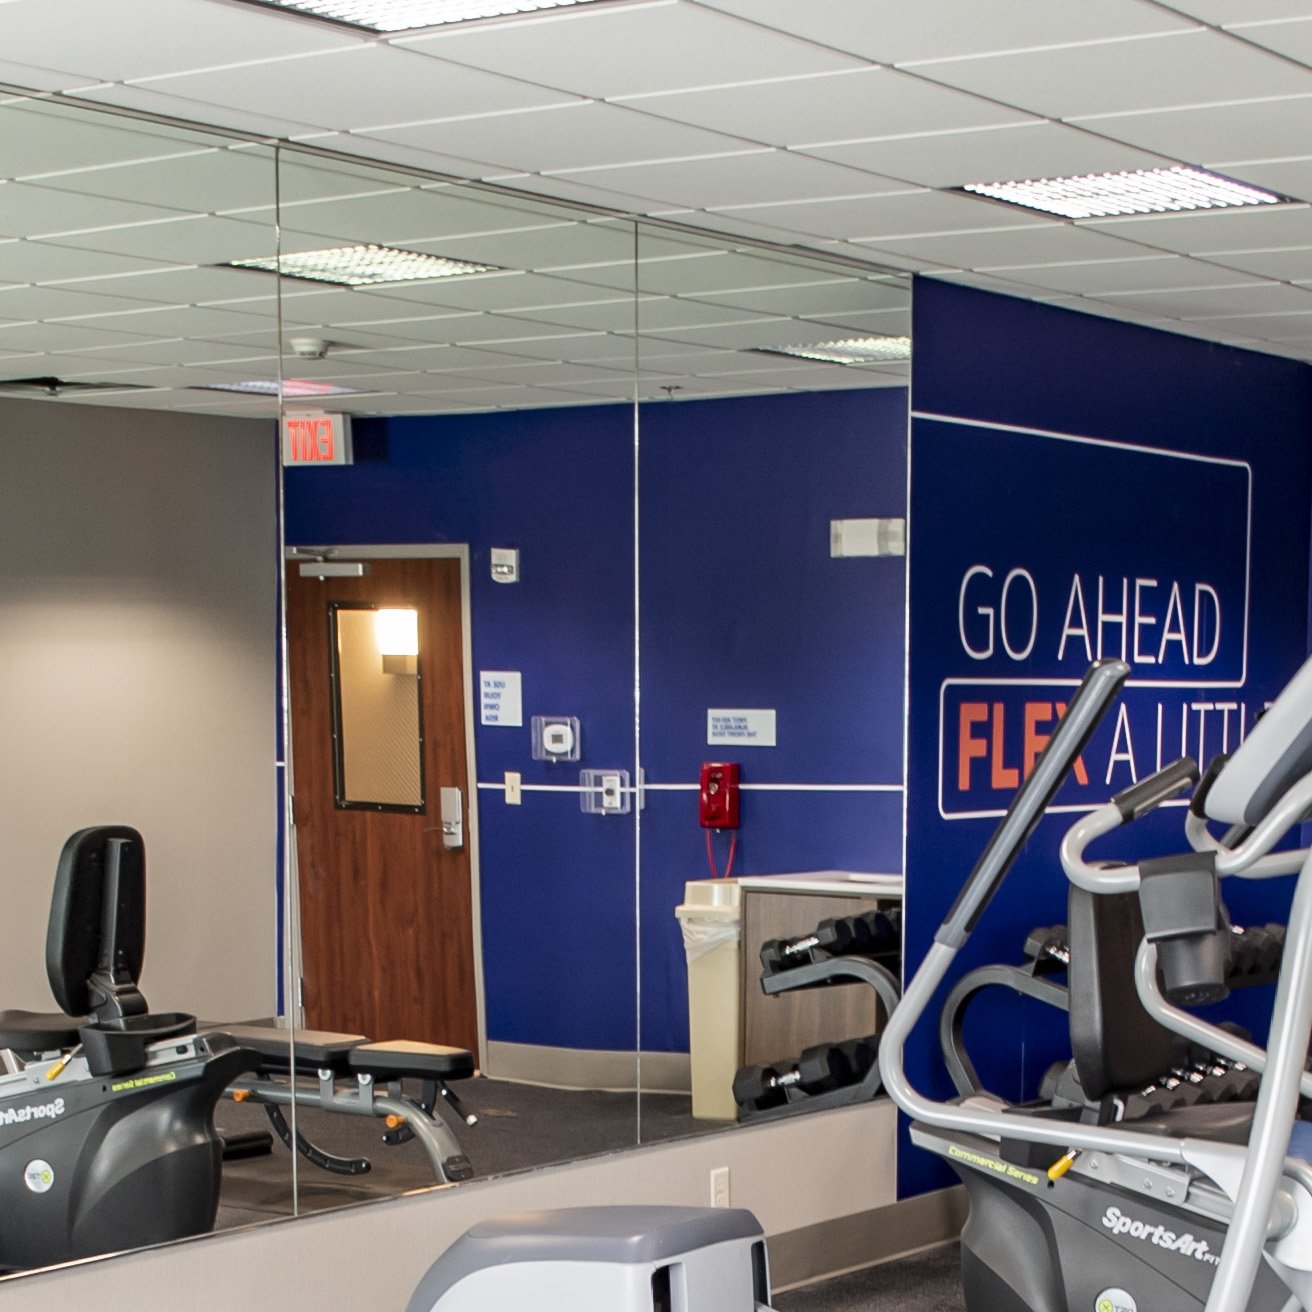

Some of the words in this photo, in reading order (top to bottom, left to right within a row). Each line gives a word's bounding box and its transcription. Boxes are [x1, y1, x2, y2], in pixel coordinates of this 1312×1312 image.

[958, 565, 1038, 660] GO
[1058, 573, 1220, 666] AHEAD
[1105, 702, 1137, 785] A
[948, 1145, 1007, 1173] Commercial
[1007, 1165, 1039, 1185] Series
[1101, 1206, 1210, 1261] SportsArt
